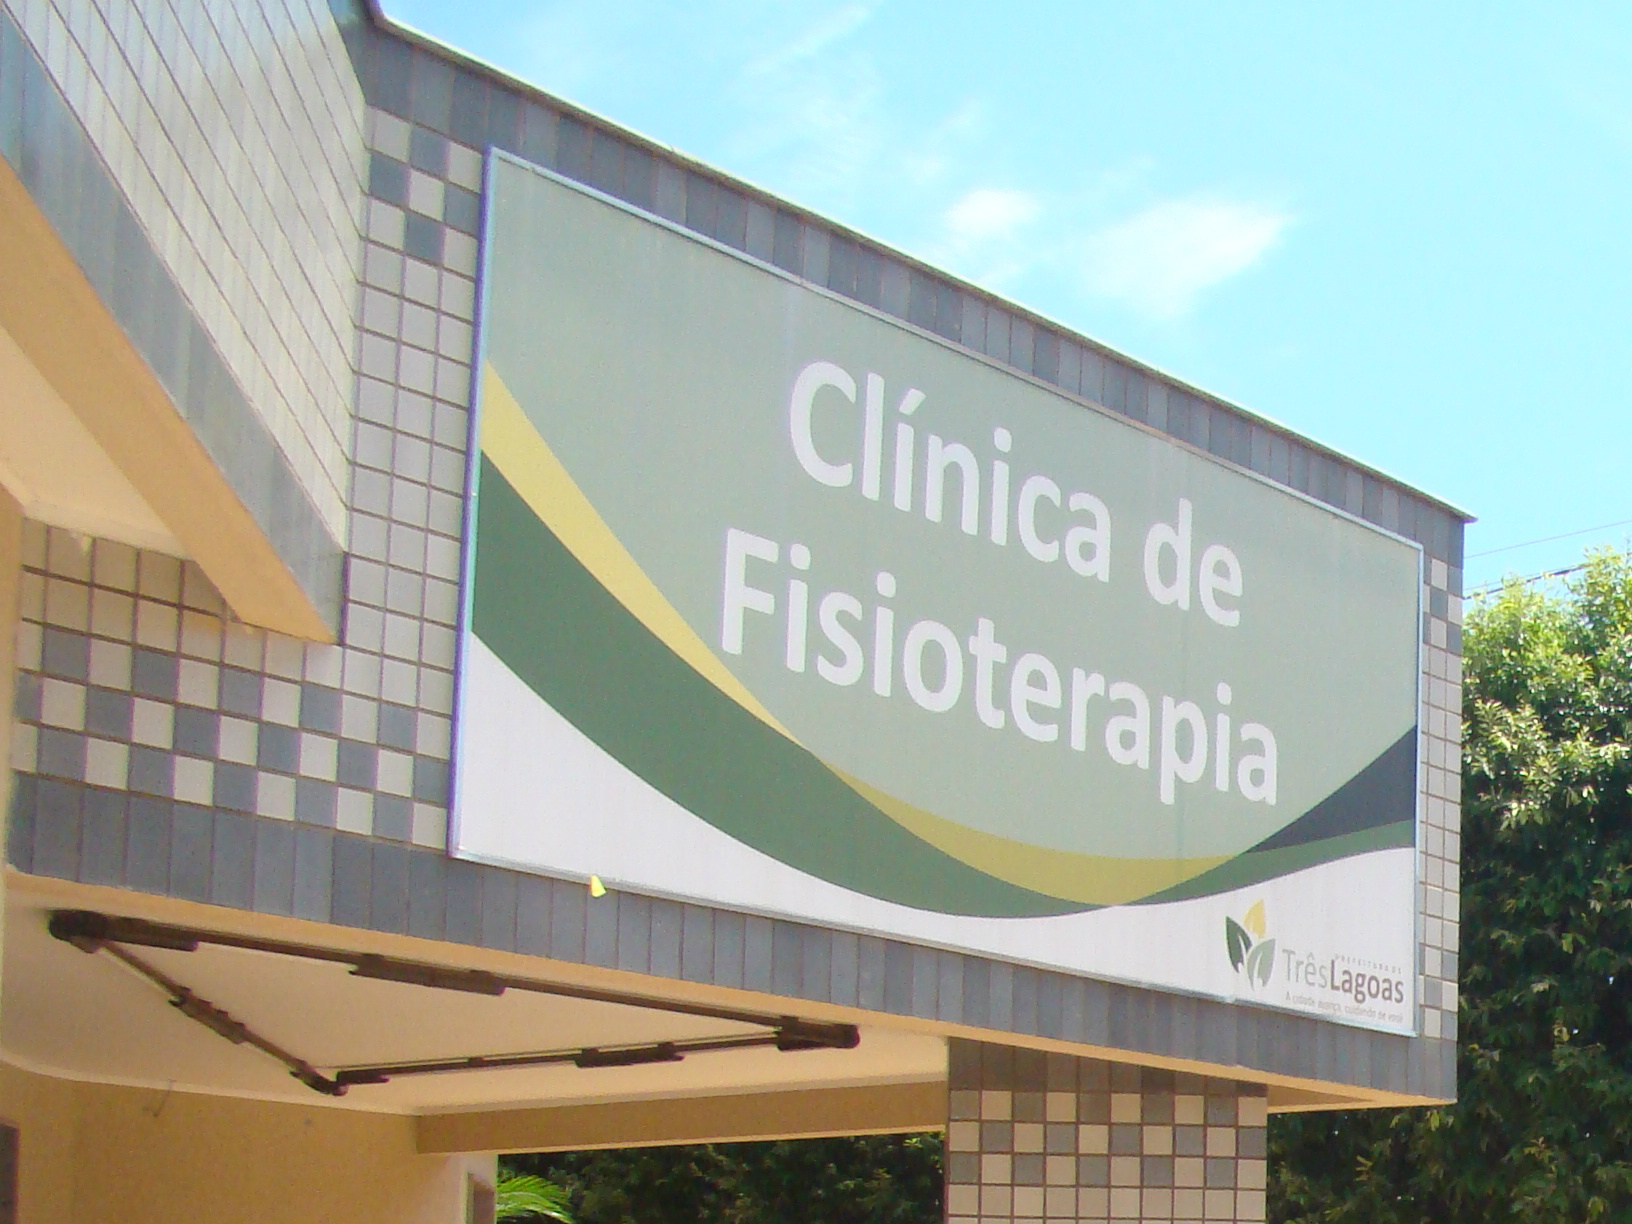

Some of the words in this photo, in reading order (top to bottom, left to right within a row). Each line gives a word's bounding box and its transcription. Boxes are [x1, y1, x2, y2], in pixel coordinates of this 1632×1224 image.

[788, 360, 1112, 583] Clínica
[1143, 497, 1244, 627] de
[721, 527, 1278, 806] Fisioterapia
